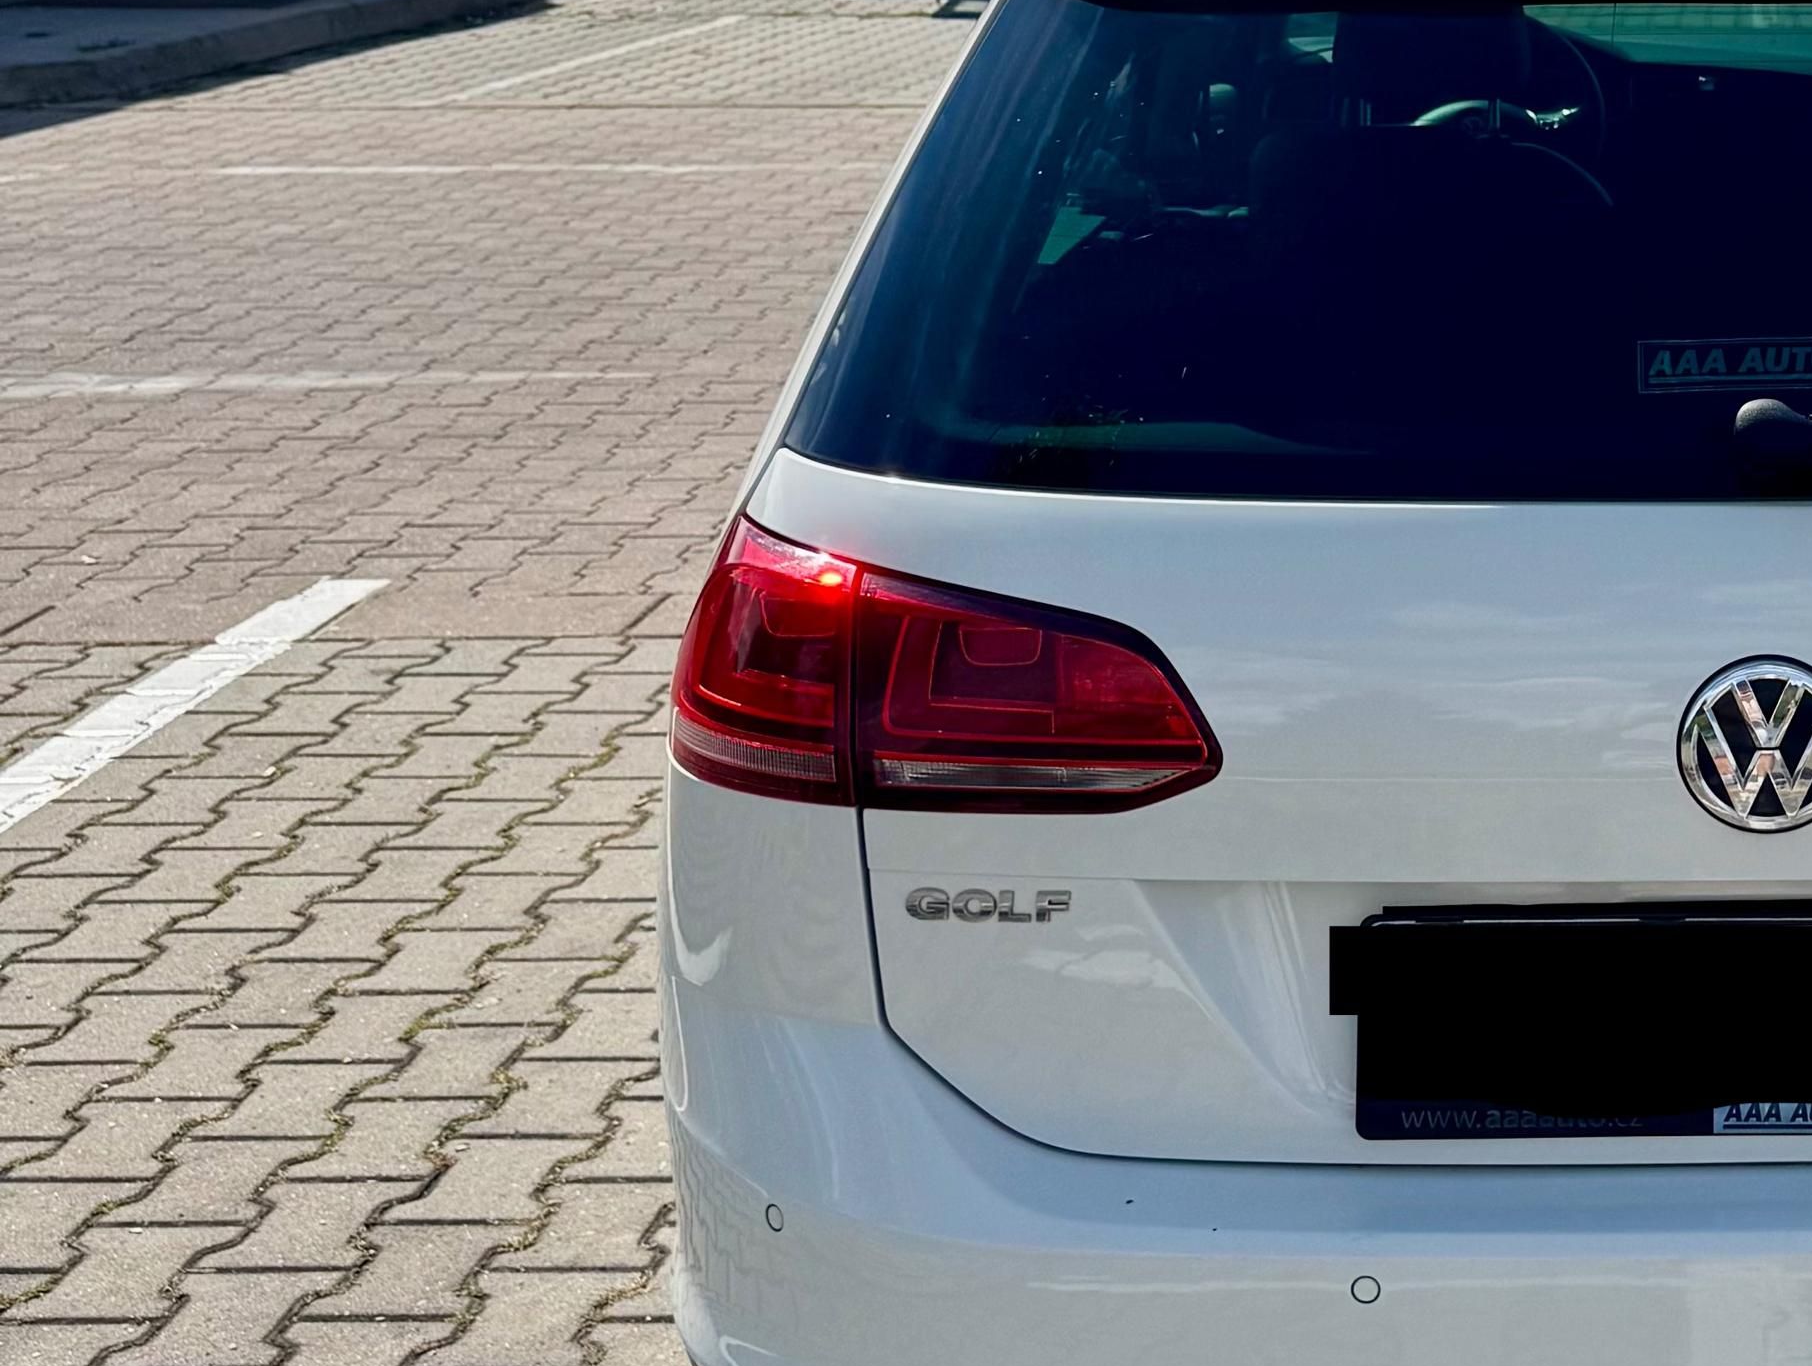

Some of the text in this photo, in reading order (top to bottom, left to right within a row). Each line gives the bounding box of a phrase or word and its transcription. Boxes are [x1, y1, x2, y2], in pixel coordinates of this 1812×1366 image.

[1648, 349, 1727, 375] AAA
[905, 886, 1072, 923] GOLF
[1723, 1102, 1782, 1123] AAA
